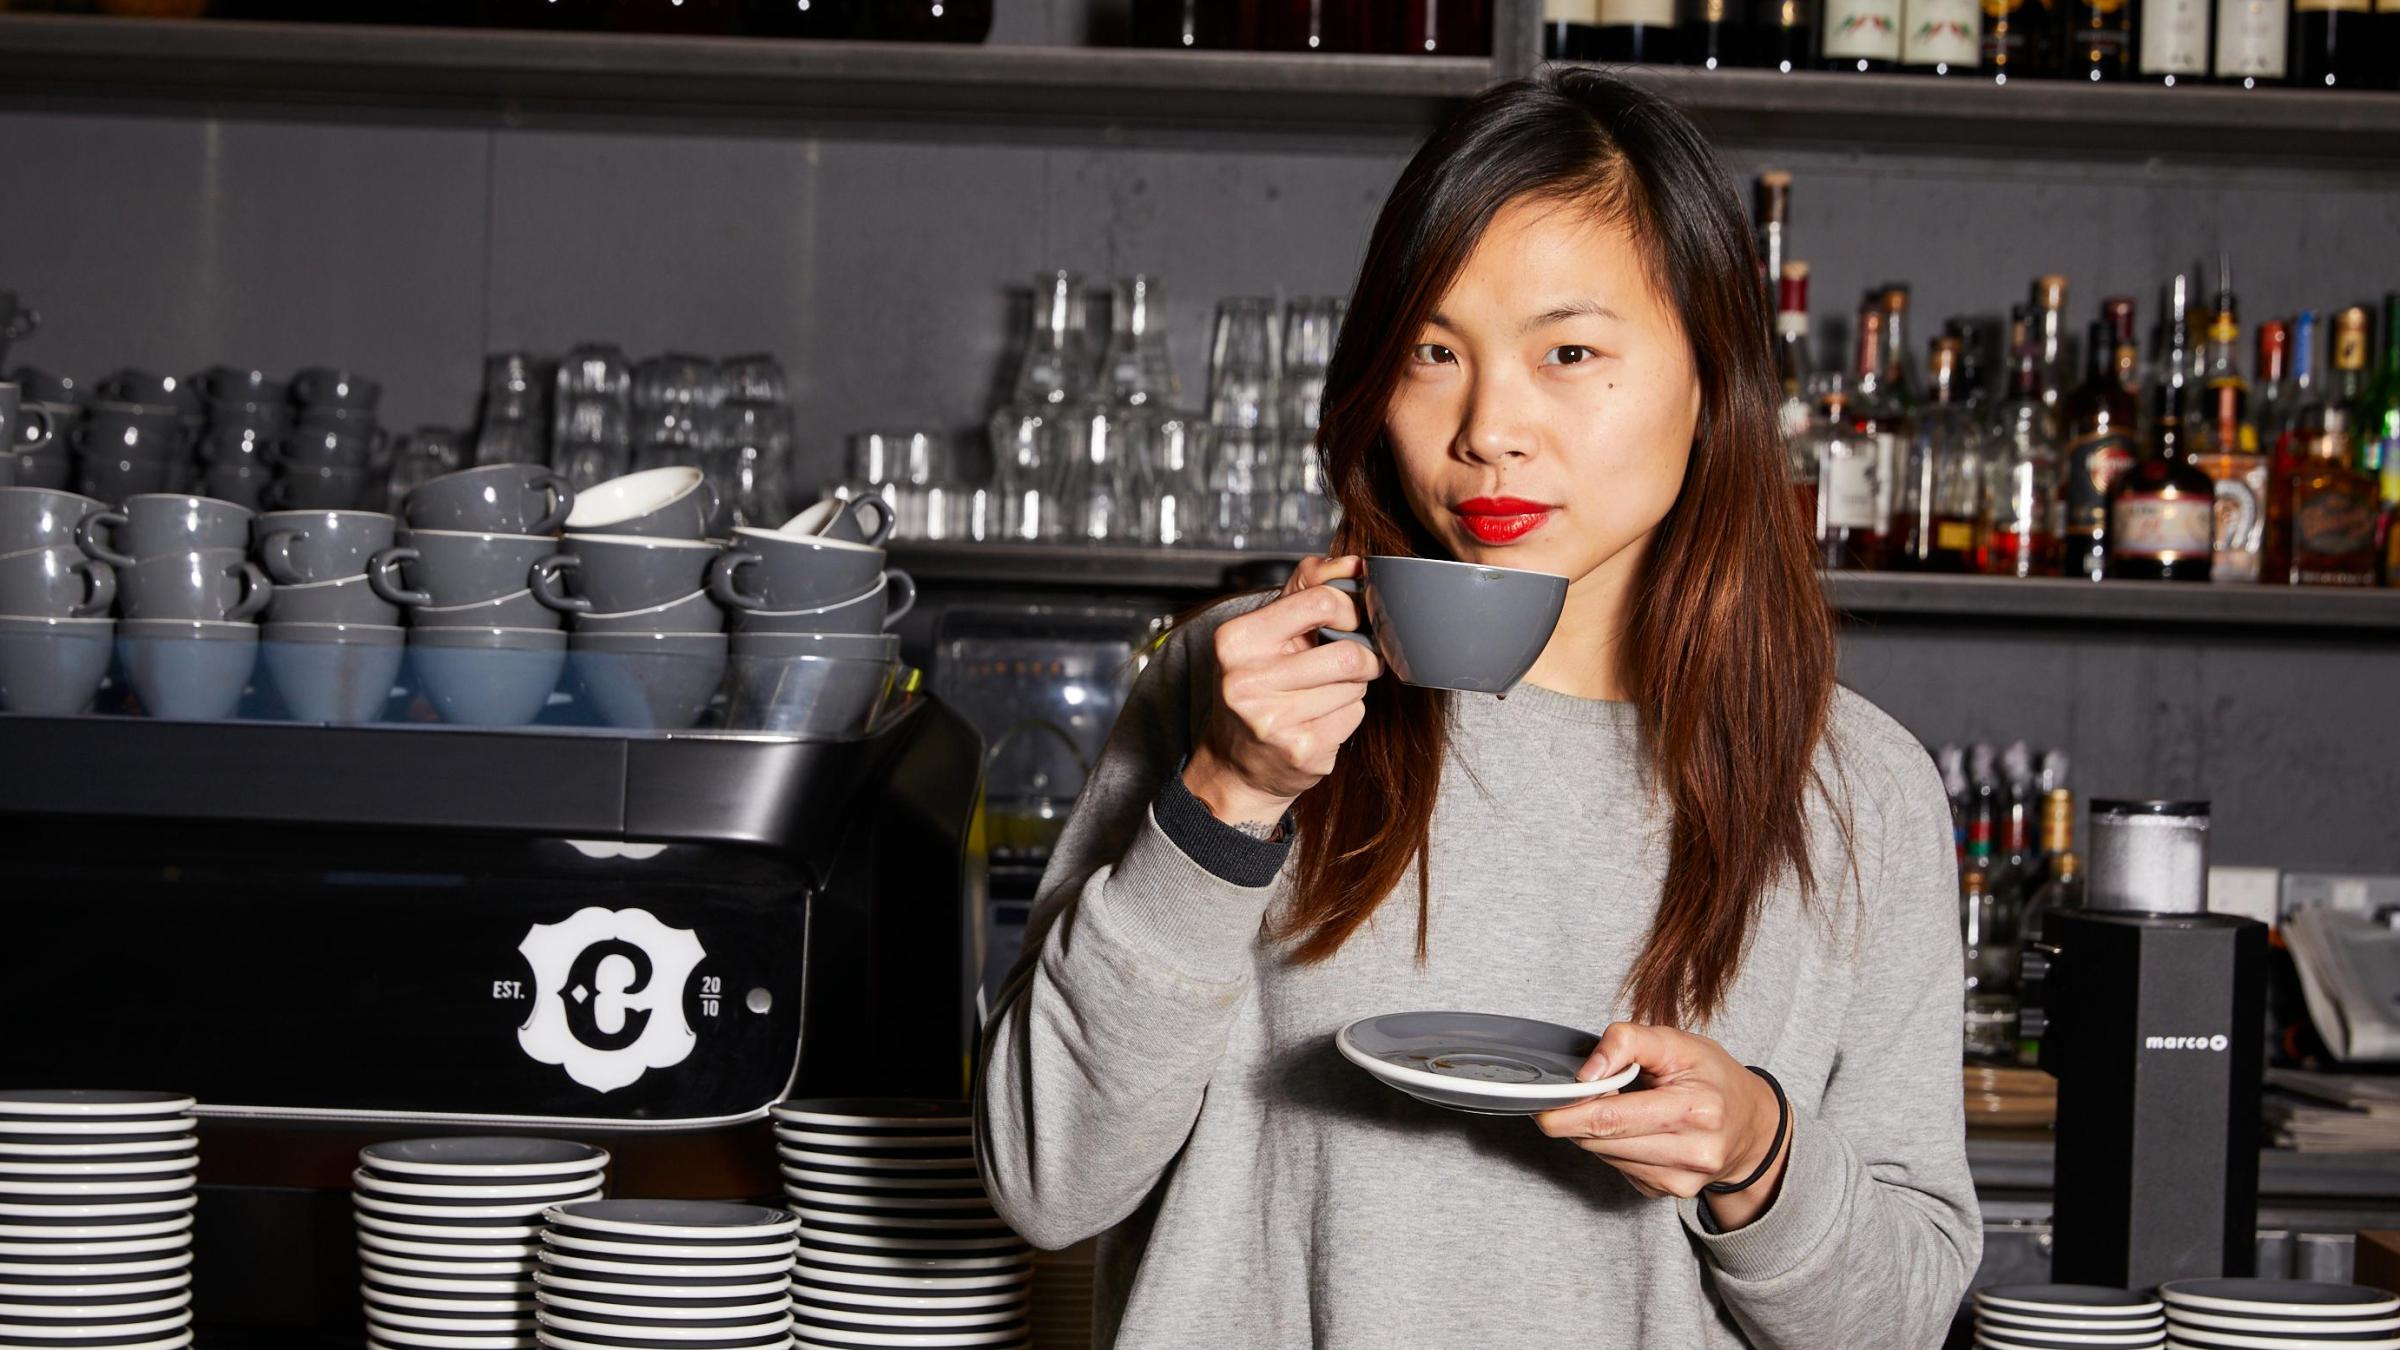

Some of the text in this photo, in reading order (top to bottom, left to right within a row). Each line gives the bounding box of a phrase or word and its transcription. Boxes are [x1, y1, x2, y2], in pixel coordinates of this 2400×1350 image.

[493, 980, 525, 999] EST.
[702, 976, 721, 993] 20
[702, 1000, 719, 1017] 10
